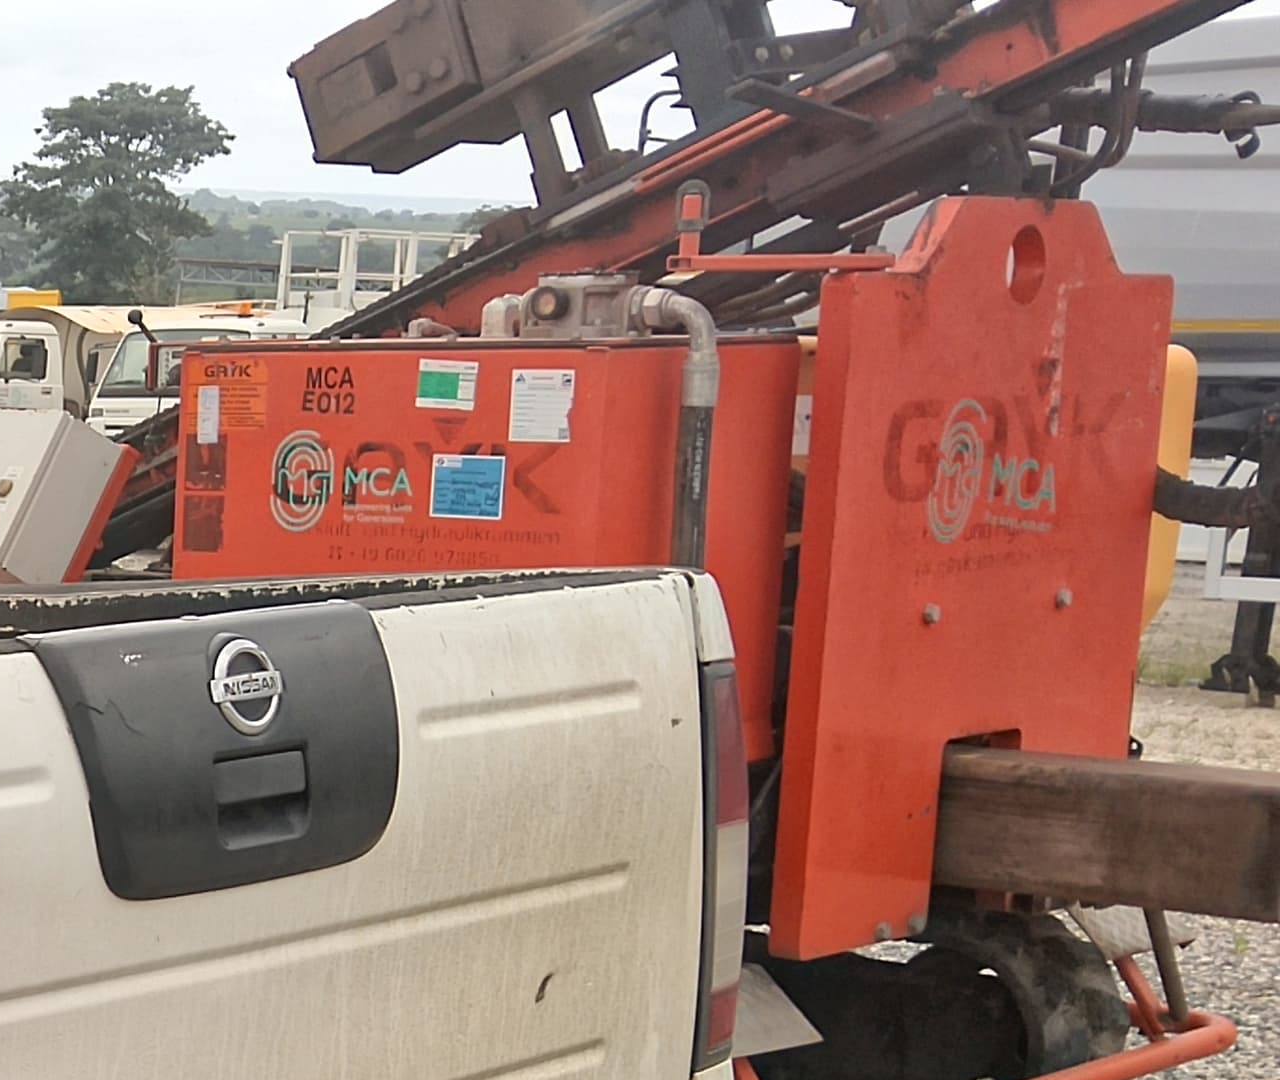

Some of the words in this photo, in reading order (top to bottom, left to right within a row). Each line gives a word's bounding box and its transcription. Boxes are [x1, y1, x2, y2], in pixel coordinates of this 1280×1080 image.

[306, 366, 355, 389] MCA
[302, 391, 355, 414] E012
[343, 467, 413, 497] MCA
[987, 453, 1056, 513] MCA
[222, 676, 278, 697] NISSAN
